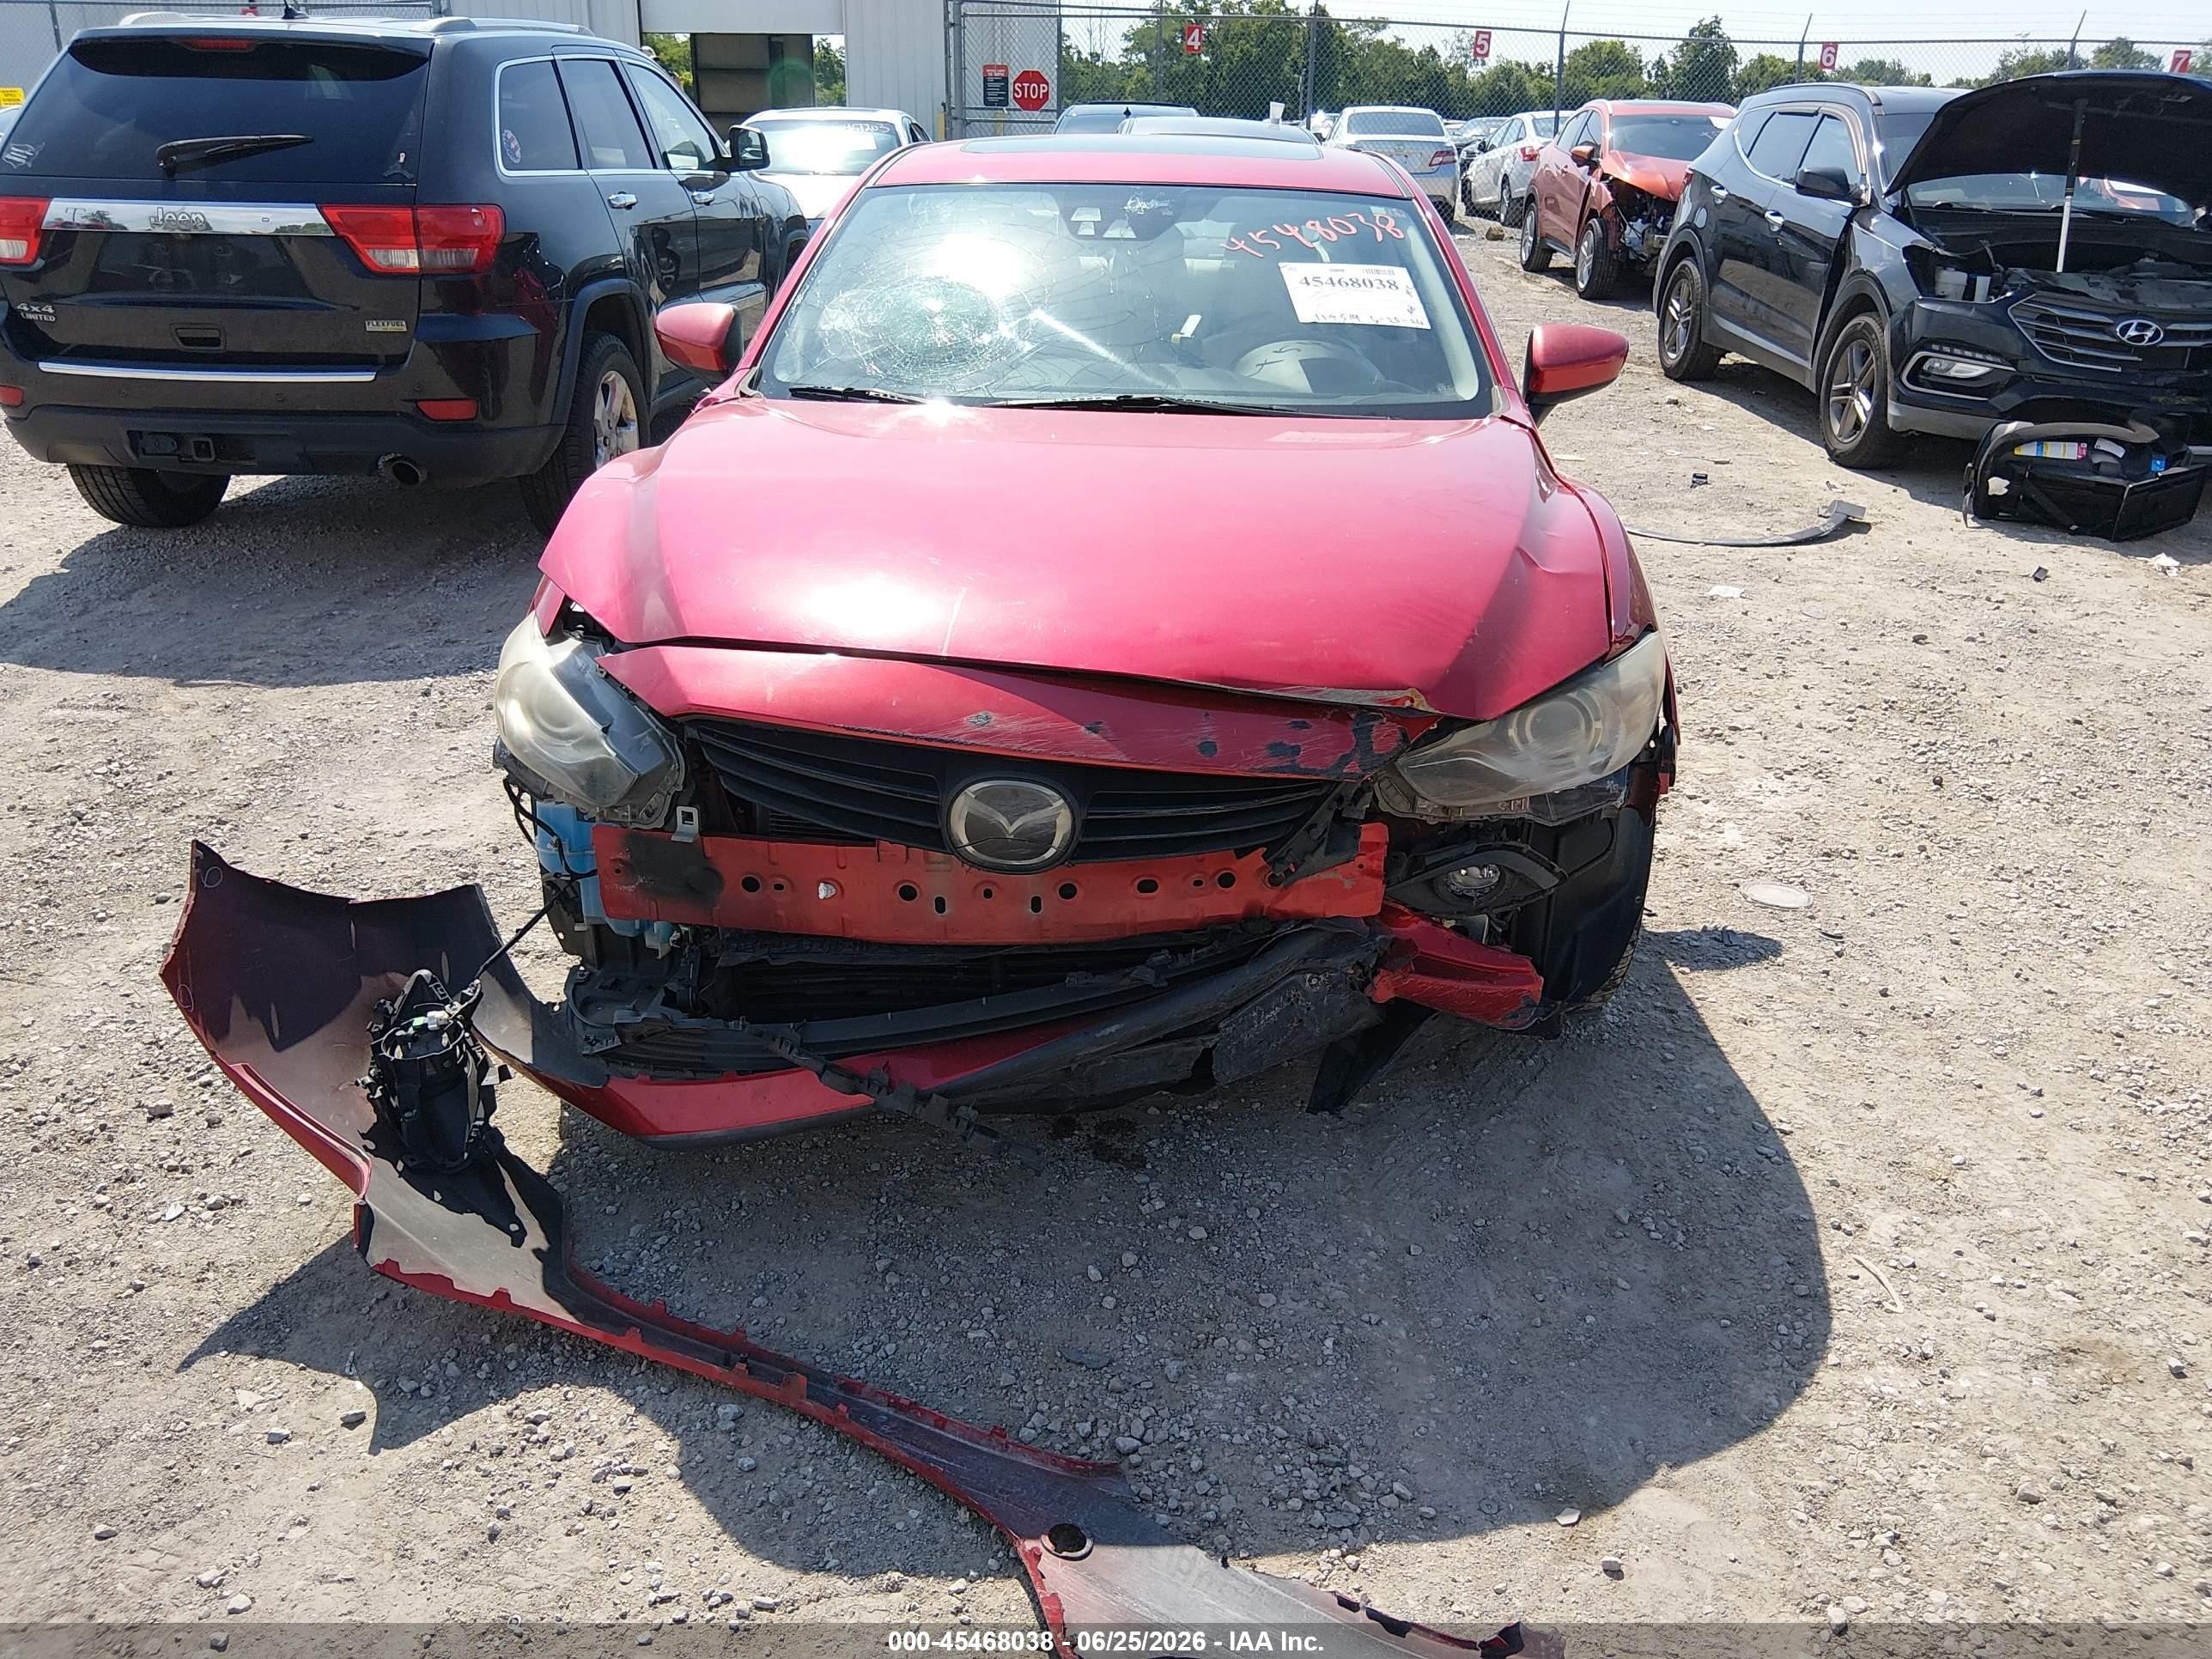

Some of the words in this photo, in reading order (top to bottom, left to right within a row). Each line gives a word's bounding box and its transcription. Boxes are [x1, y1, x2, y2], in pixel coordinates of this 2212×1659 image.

[1187, 28, 1201, 50] 4
[1475, 33, 1490, 54] 5
[1821, 46, 1836, 67] 6
[2173, 52, 2190, 74] 7
[1014, 82, 1048, 100] STOP
[149, 206, 208, 231] Jeep
[1299, 276, 1400, 291] 45468038
[17, 302, 56, 313] 4x4
[21, 312, 56, 322] LIMITED
